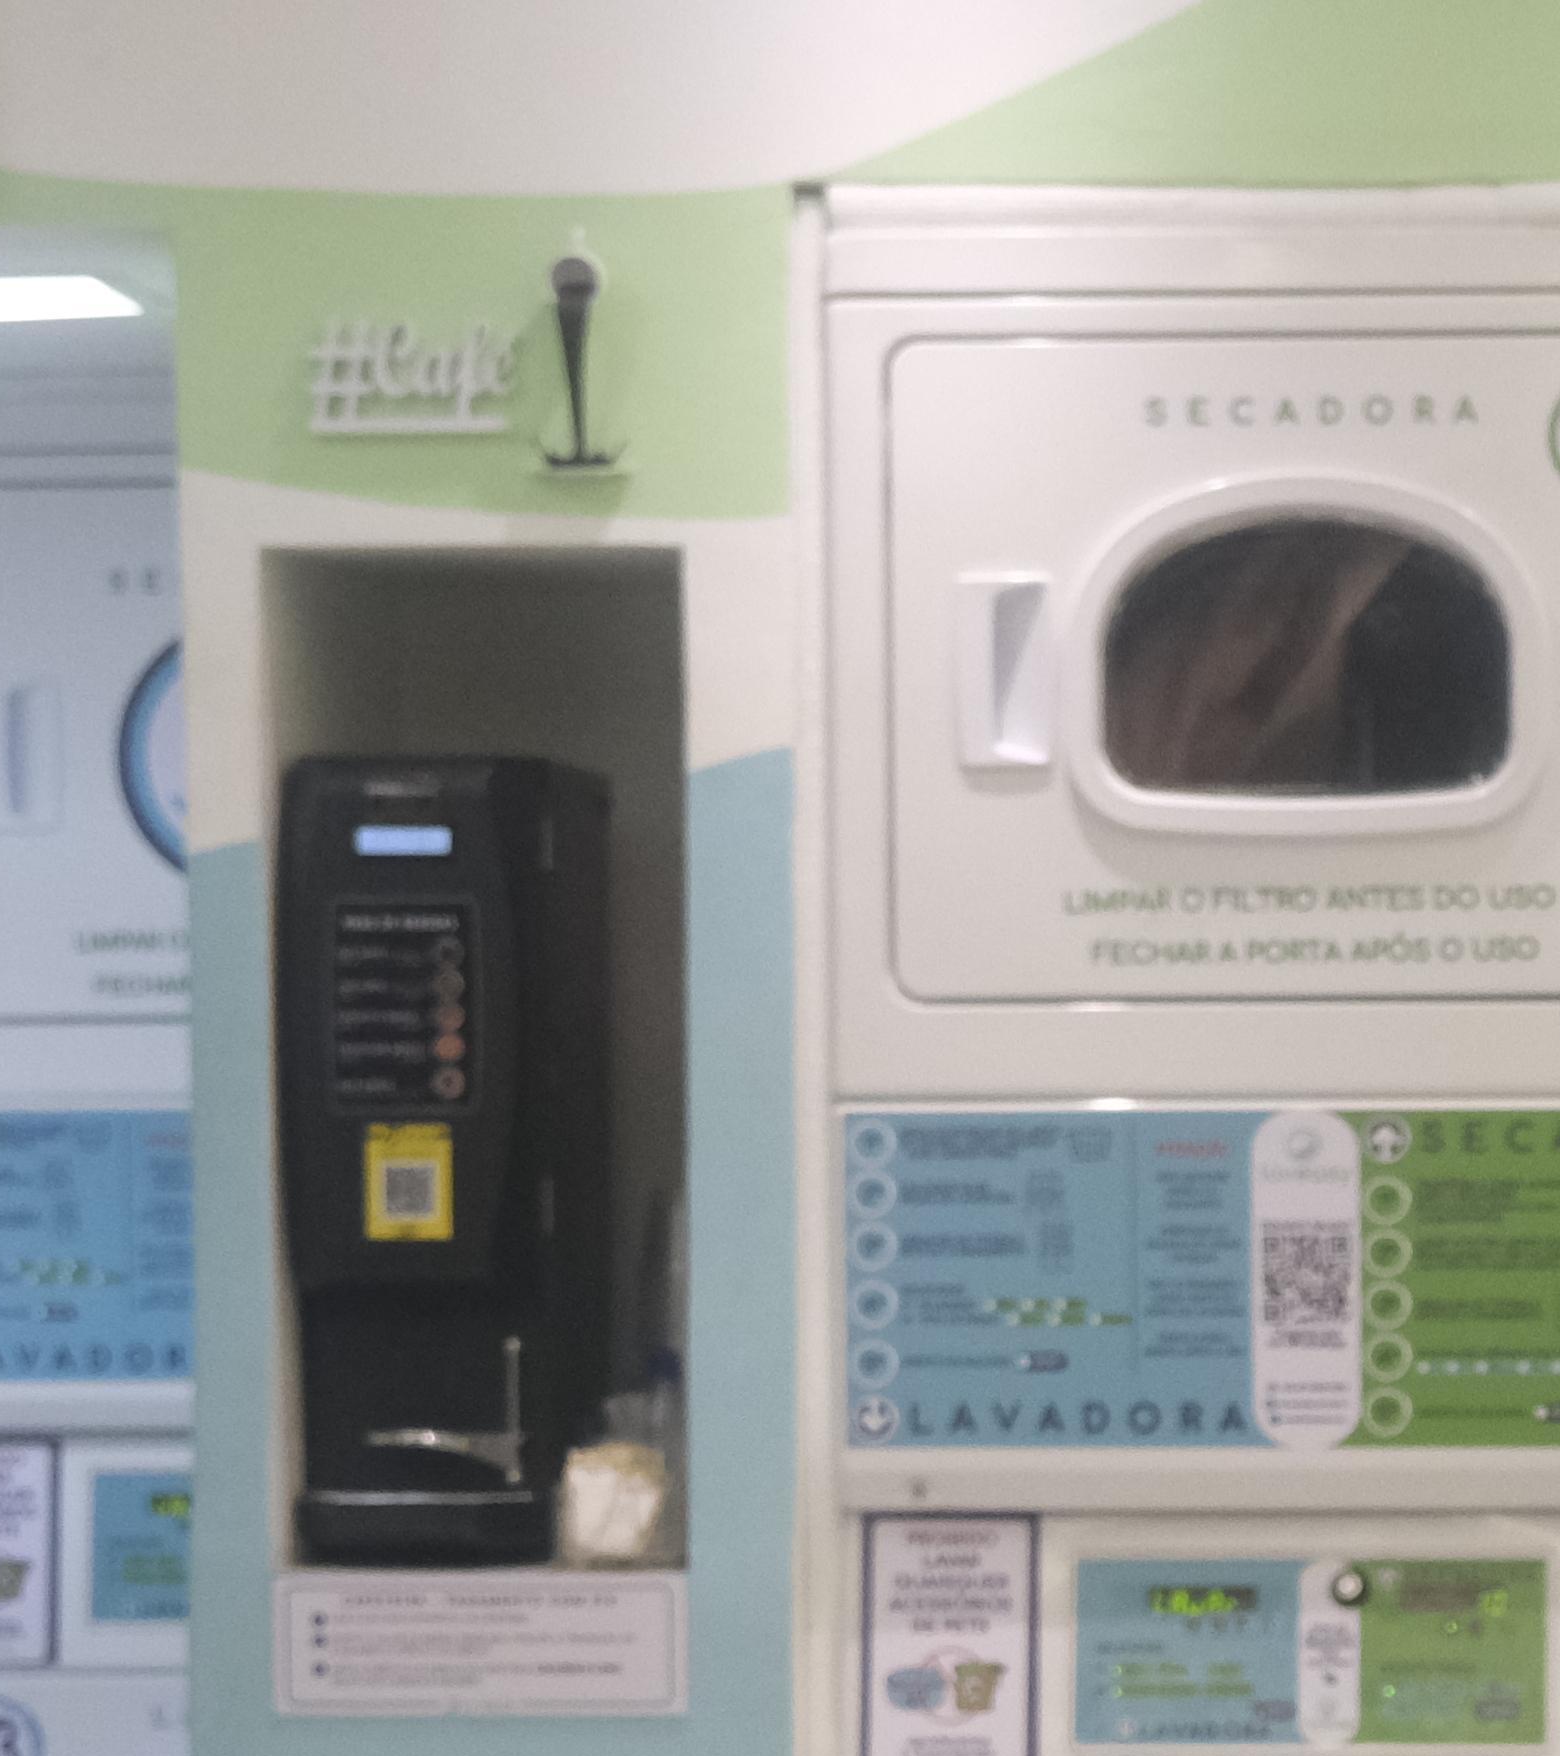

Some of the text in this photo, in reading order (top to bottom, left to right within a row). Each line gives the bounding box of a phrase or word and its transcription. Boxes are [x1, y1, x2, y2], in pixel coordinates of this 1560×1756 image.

[1145, 396, 1482, 427] SECADORA
[1065, 883, 1556, 916] LIMPAR O FILTRO ANTES DO USO
[1090, 933, 1539, 966] FECHAR A PORTA APÓS O USO
[906, 1400, 1247, 1437] LAVADORA
